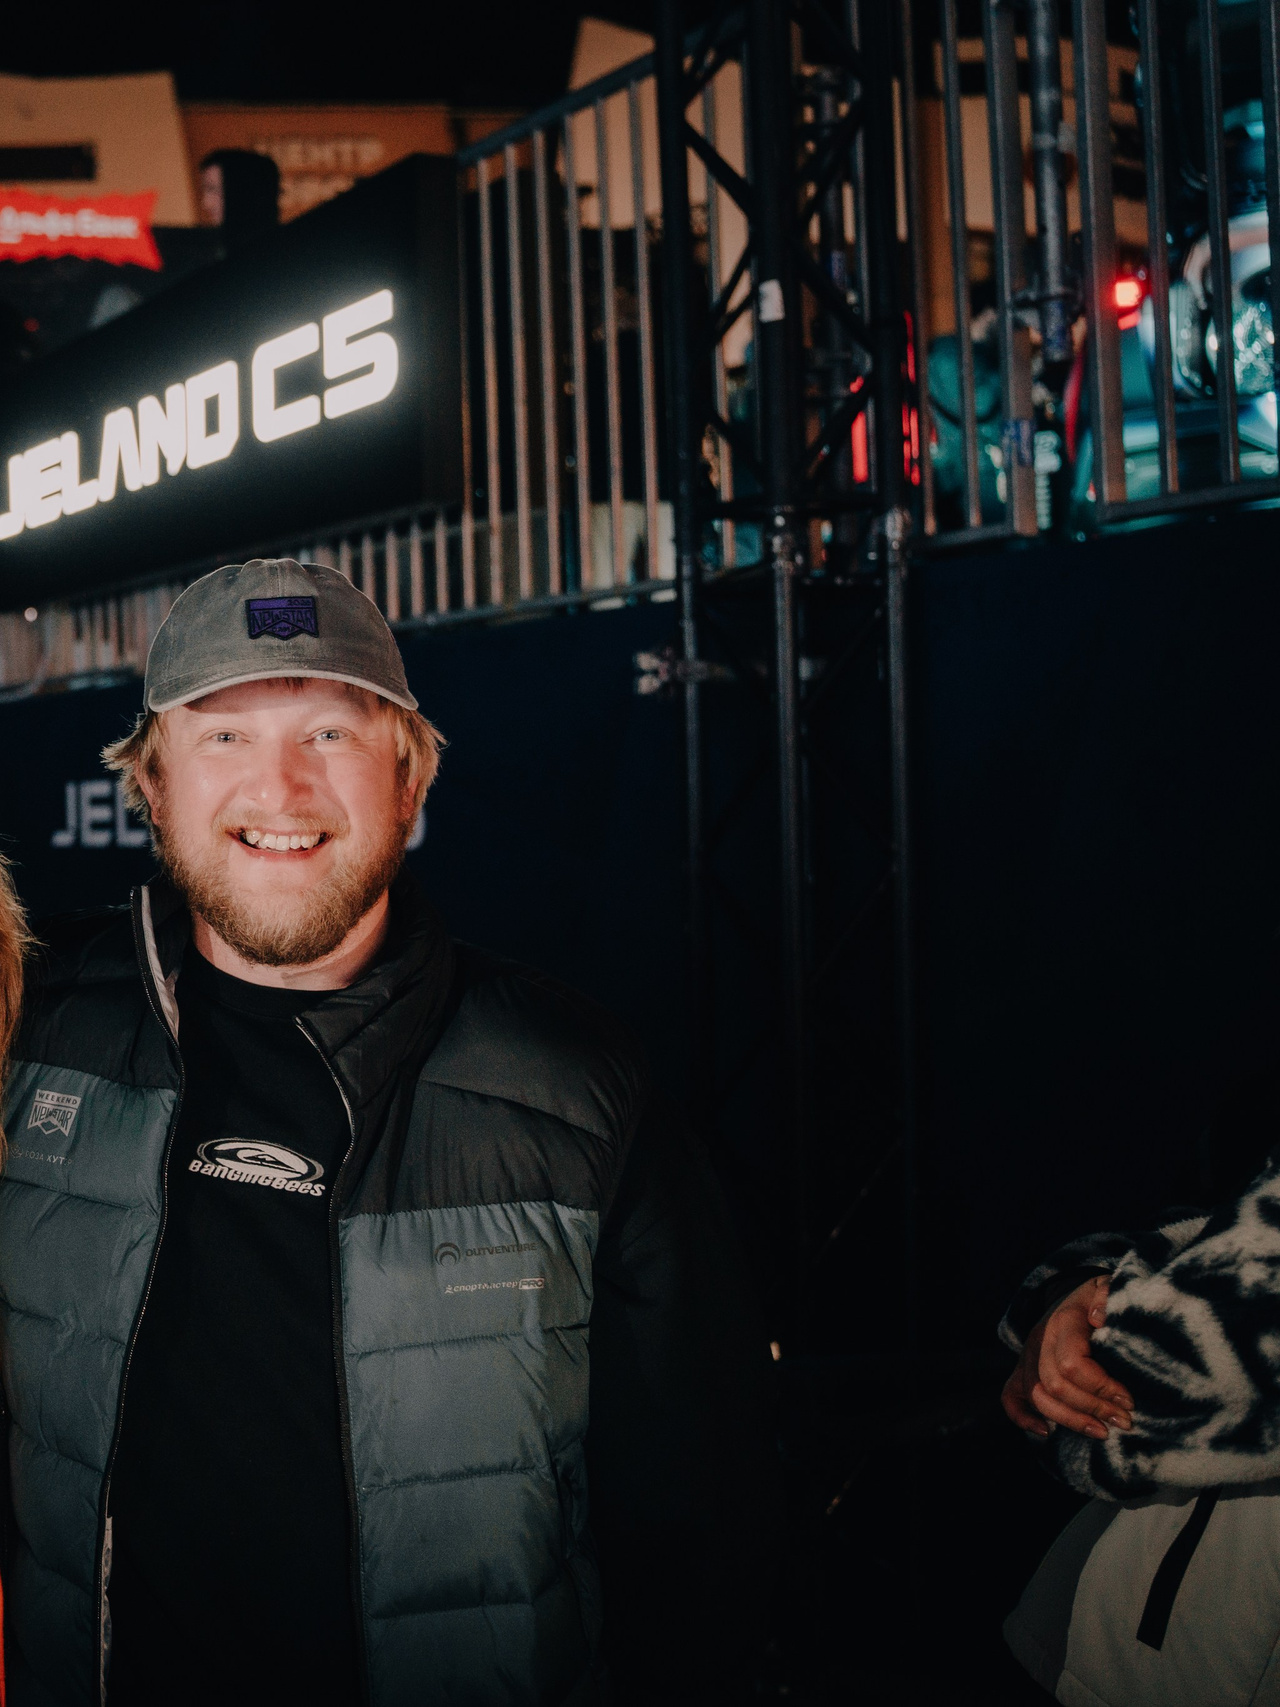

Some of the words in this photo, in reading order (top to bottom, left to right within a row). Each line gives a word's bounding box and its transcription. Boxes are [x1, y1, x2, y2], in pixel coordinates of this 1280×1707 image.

[250, 609, 317, 635] NEWSTAR
[37, 1092, 78, 1106] WEEKEND
[30, 1103, 74, 1131] NEWSTAR
[46, 1154, 73, 1166] ХУТР
[465, 1242, 538, 1257] OUTVENTURE
[519, 1278, 545, 1290] PRO
